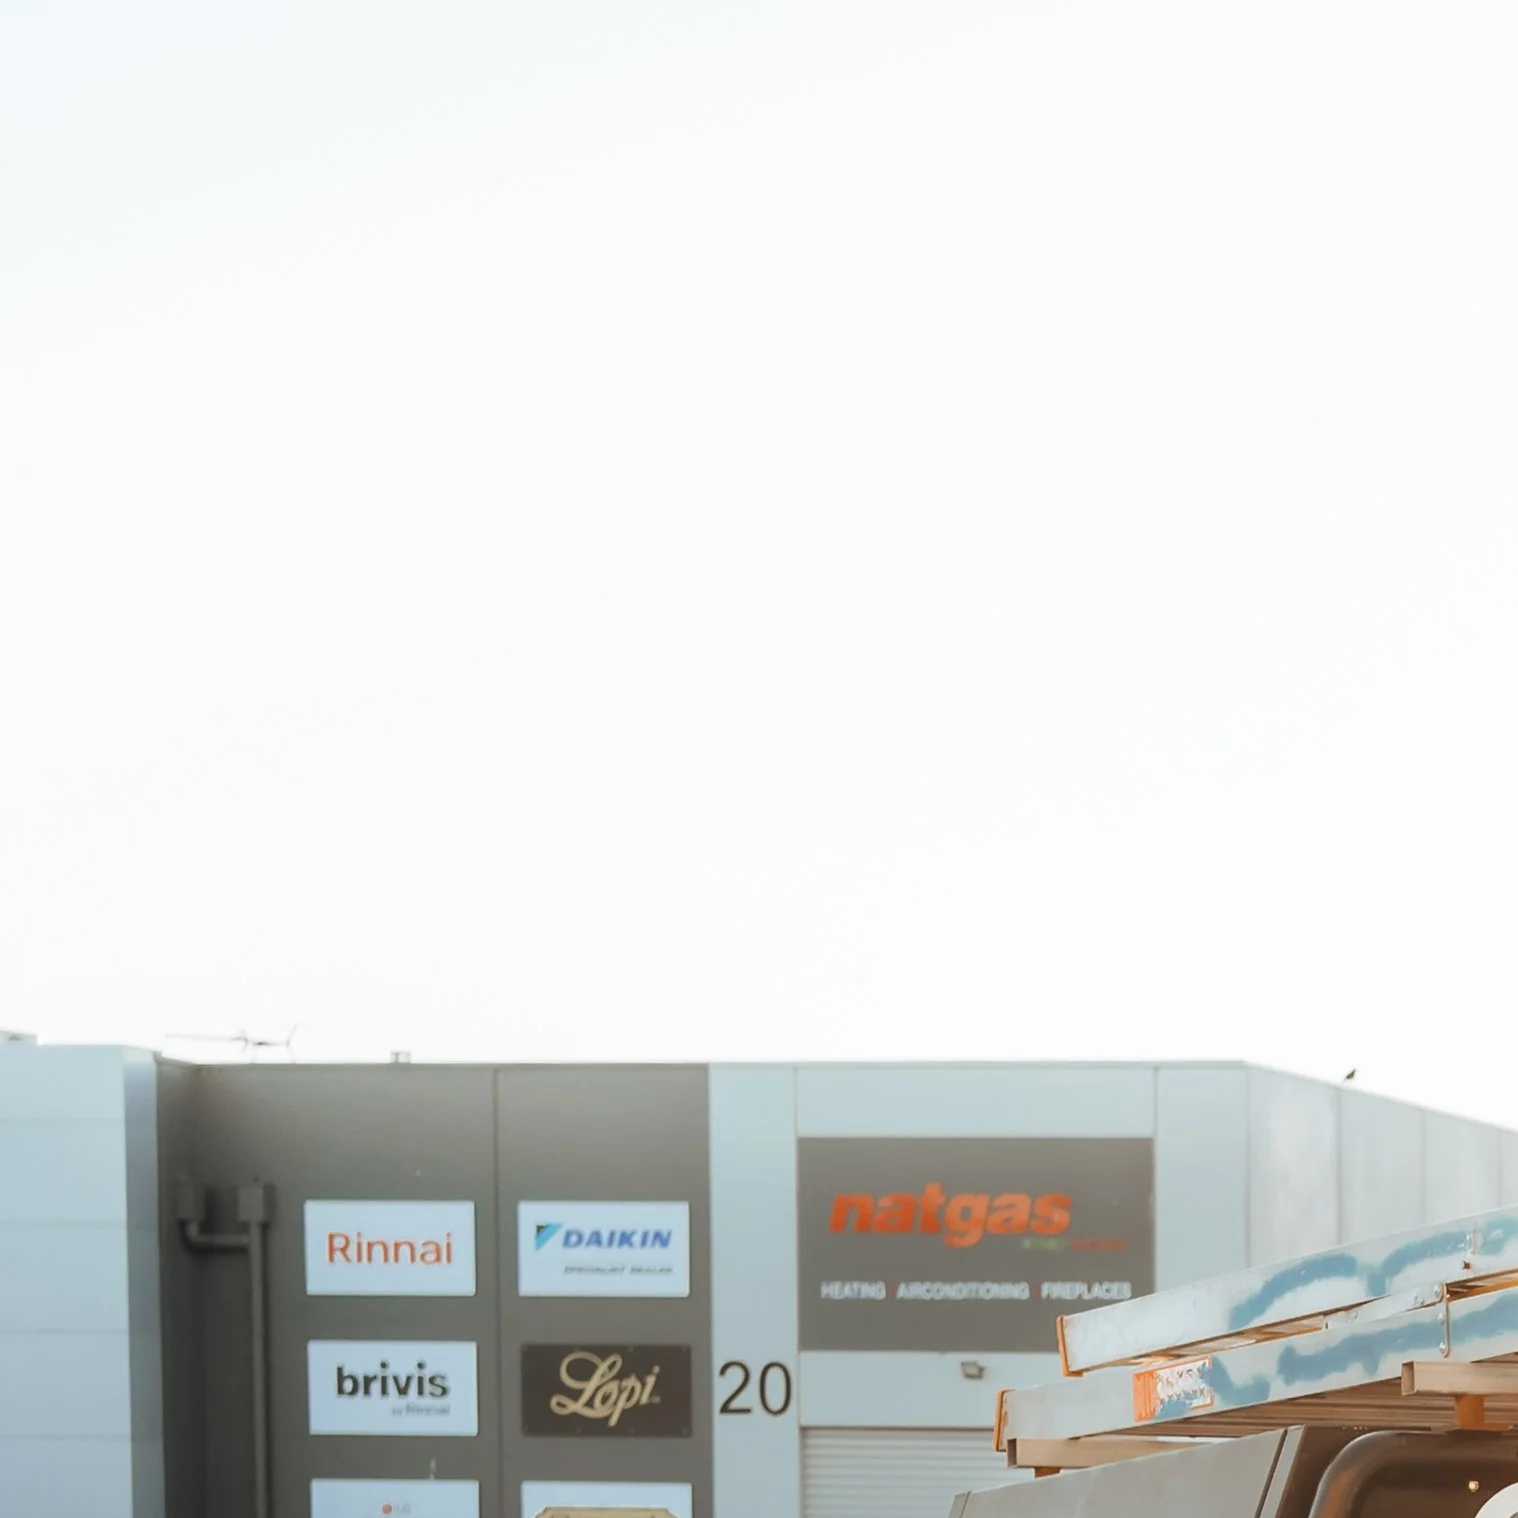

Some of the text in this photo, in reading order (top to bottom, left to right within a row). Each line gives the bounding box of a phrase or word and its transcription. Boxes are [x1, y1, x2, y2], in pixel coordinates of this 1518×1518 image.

[829, 1183, 1072, 1248] natgas
[326, 1231, 454, 1265] Rinnai
[562, 1229, 672, 1249] DAIKIN
[820, 1281, 886, 1300] HEATING
[1041, 1281, 1132, 1300] FIREPLACES
[336, 1360, 450, 1397] brivis
[550, 1351, 660, 1427] Lopi
[717, 1361, 792, 1416] 20
